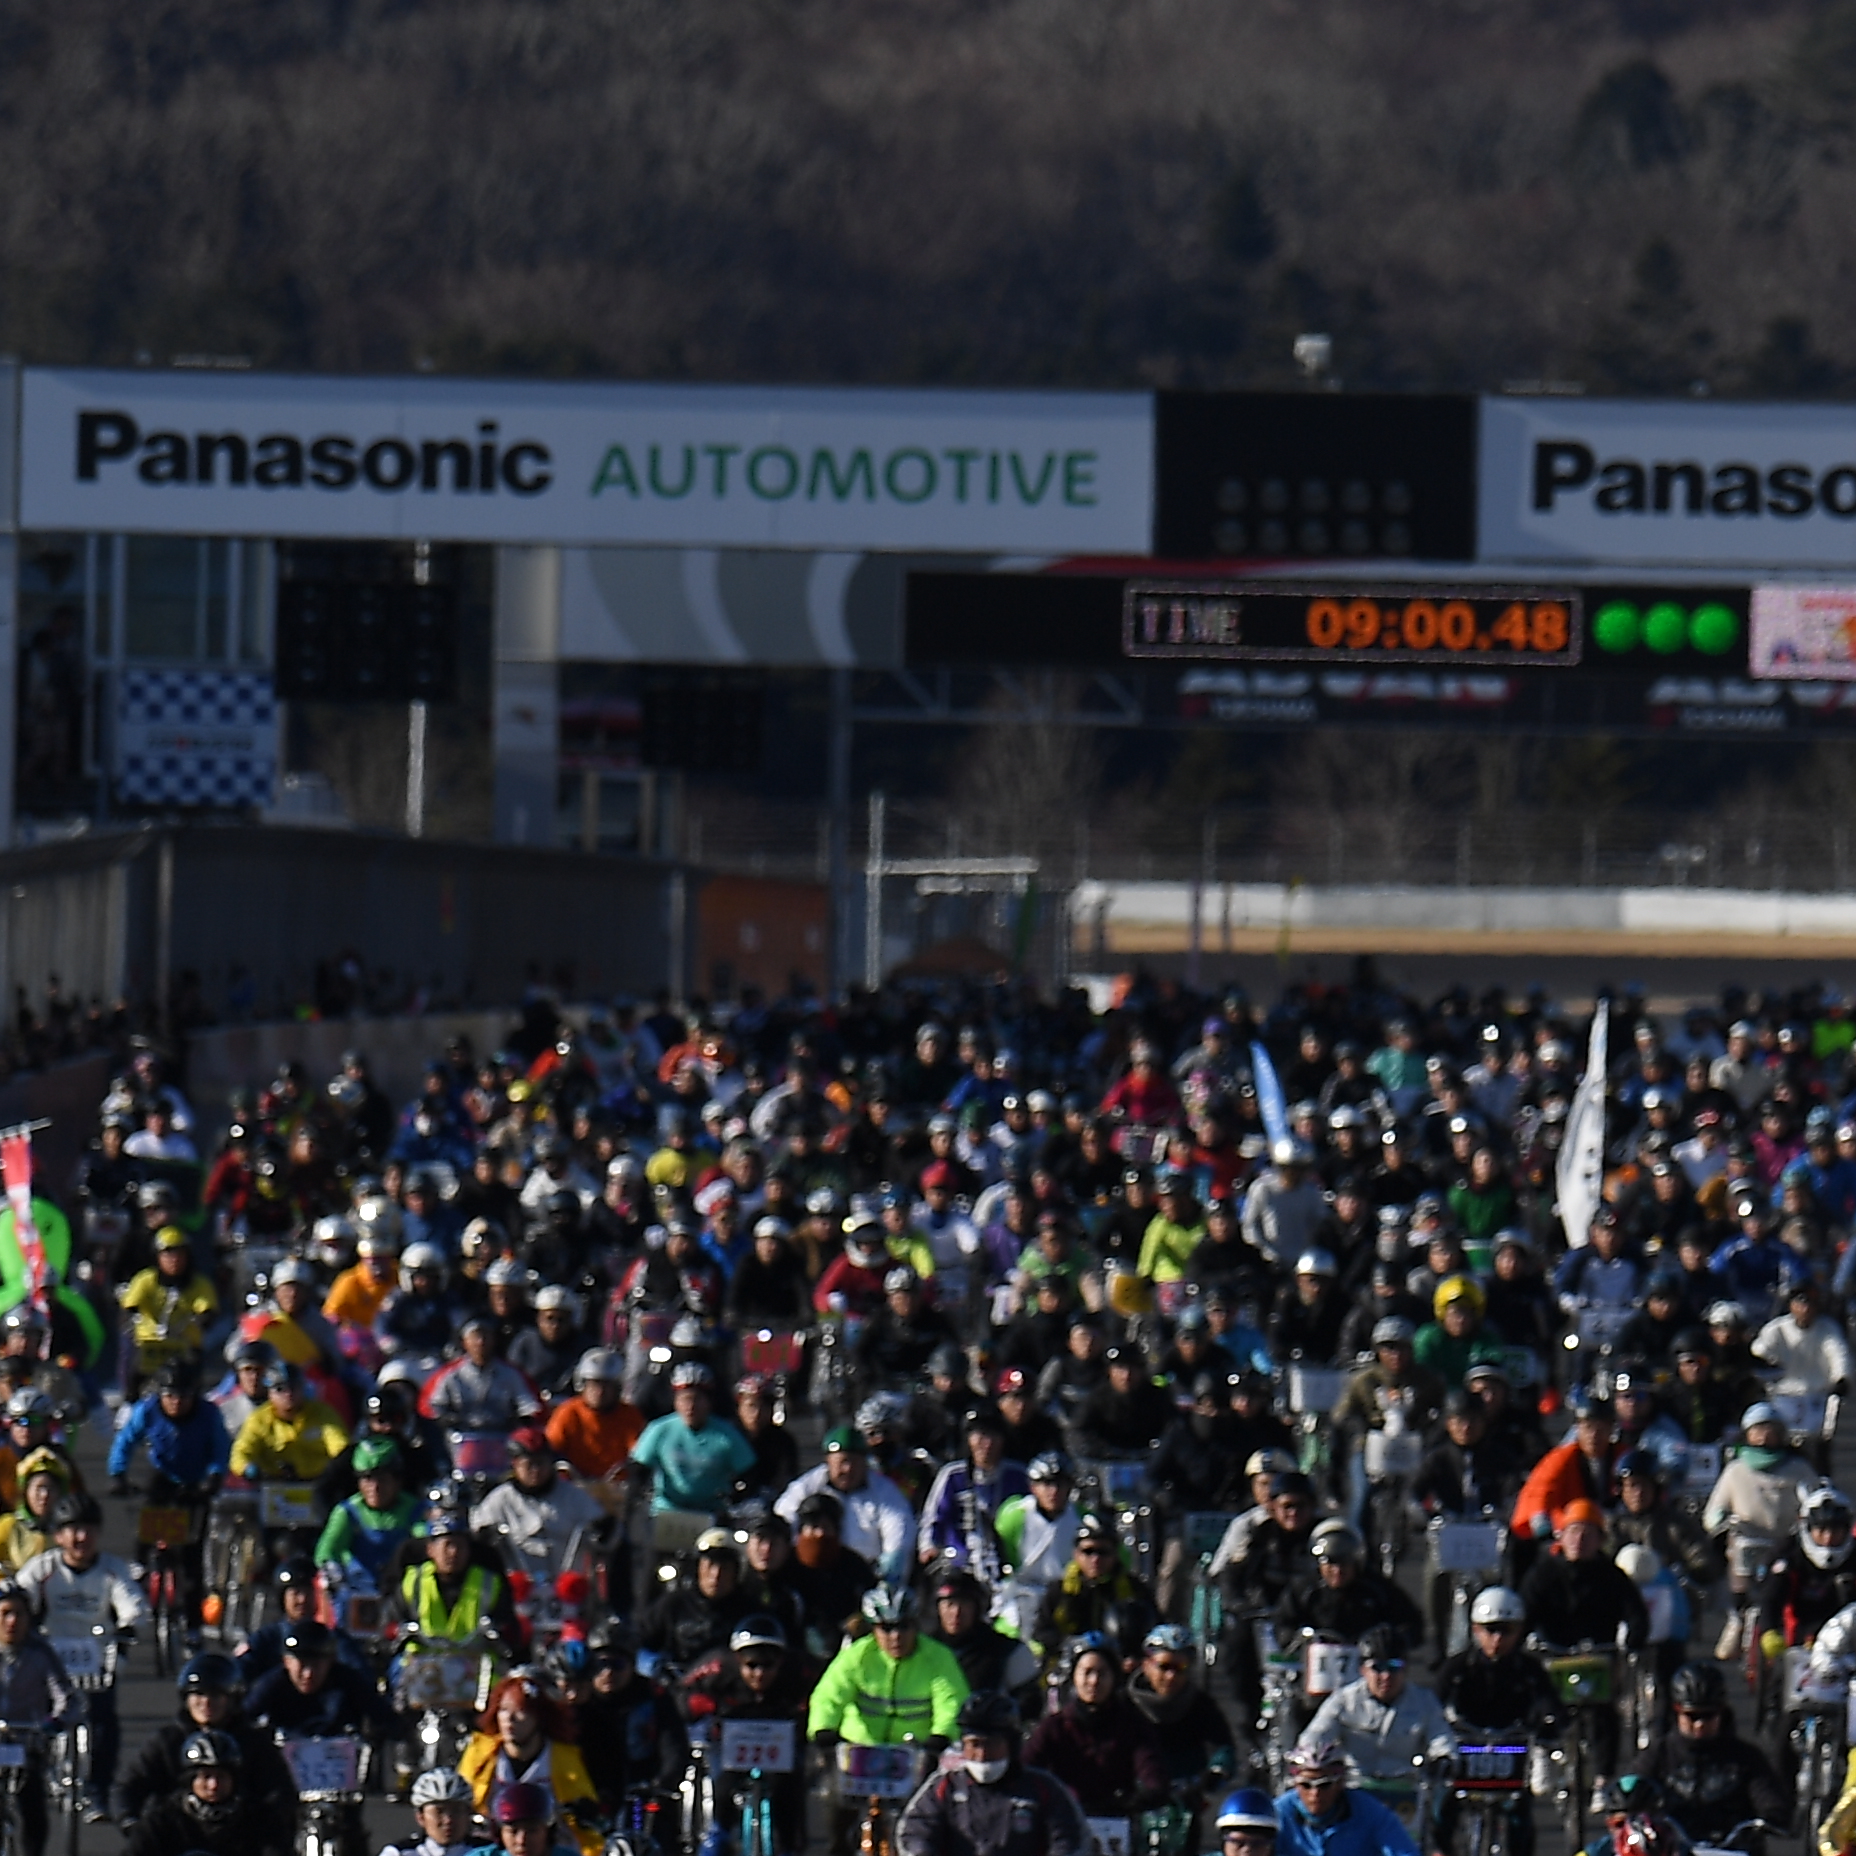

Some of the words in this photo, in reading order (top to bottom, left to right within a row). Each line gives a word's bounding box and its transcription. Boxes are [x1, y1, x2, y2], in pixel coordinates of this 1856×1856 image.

[74, 410, 556, 496] Panasonic
[589, 442, 1099, 508] AUTOMOTIVE
[1142, 597, 1242, 645] TIME
[1305, 597, 1570, 653] 09:00.48
